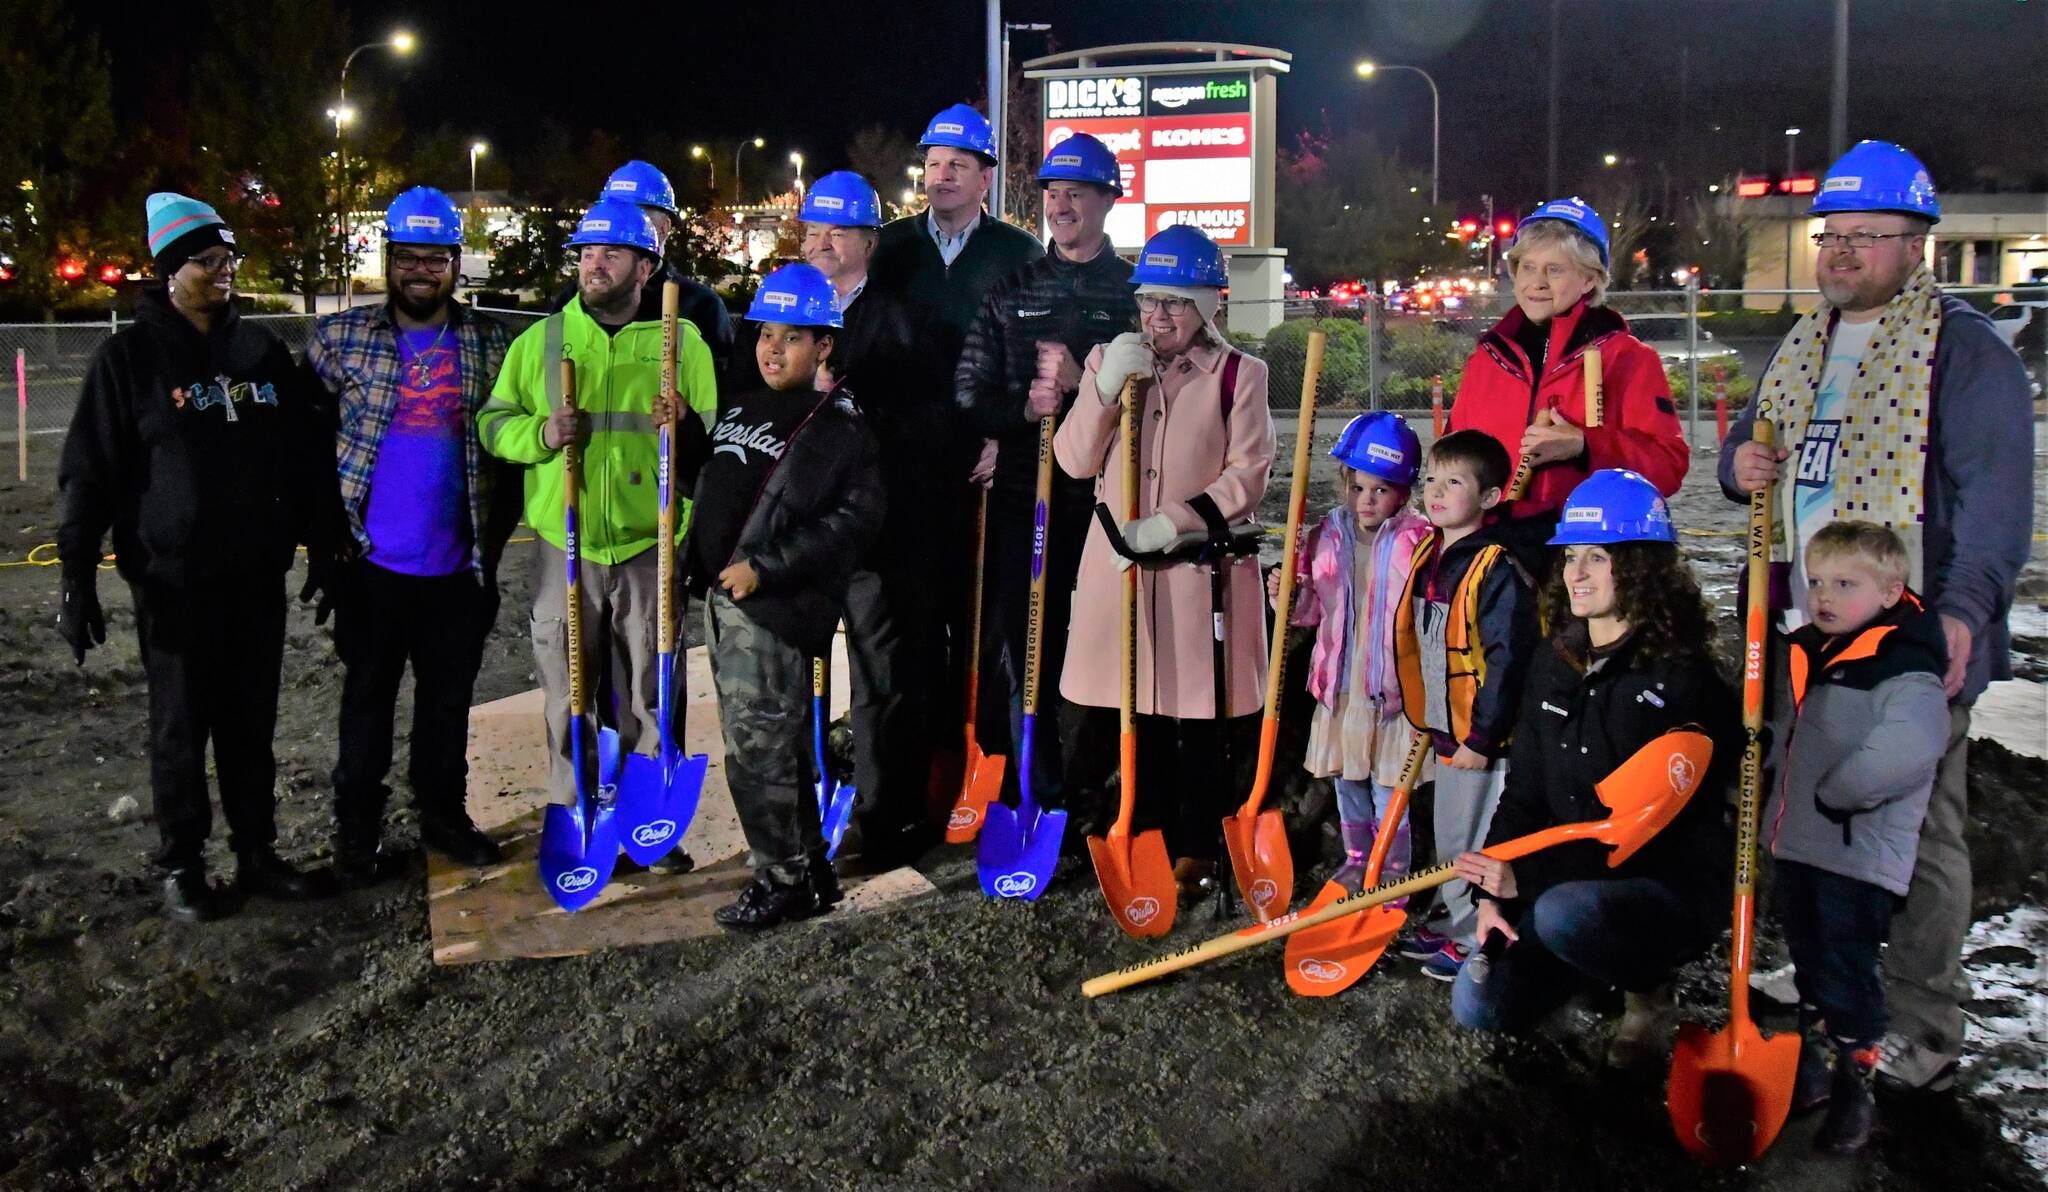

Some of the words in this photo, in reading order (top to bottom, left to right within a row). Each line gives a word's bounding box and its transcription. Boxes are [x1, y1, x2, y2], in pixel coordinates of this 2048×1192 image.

[1049, 78, 1141, 108] DICK'S
[1206, 80, 1247, 98] fresh
[1049, 108, 1103, 118] SPORTING
[1080, 129, 1141, 154] rget
[1152, 127, 1246, 147] KOHL'S
[1177, 209, 1246, 228] FAMOUS
[662, 314, 671, 363] FEDERAL
[1596, 384, 1604, 427] FEDER
[660, 456, 669, 486] 2022
[1510, 455, 1531, 493] DERAL
[1797, 441, 1831, 481] EA
[567, 532, 575, 560] 2022
[1034, 526, 1044, 555] 2022
[1752, 525, 1763, 559] WAY
[568, 593, 579, 706] GROUNDBREAKING
[1024, 592, 1039, 707] GROUNDBREAKING
[1746, 641, 1761, 680] 2022
[1118, 954, 1170, 976] FEDERAL
[1174, 944, 1201, 958] WAY
[1266, 913, 1299, 929] 2022
